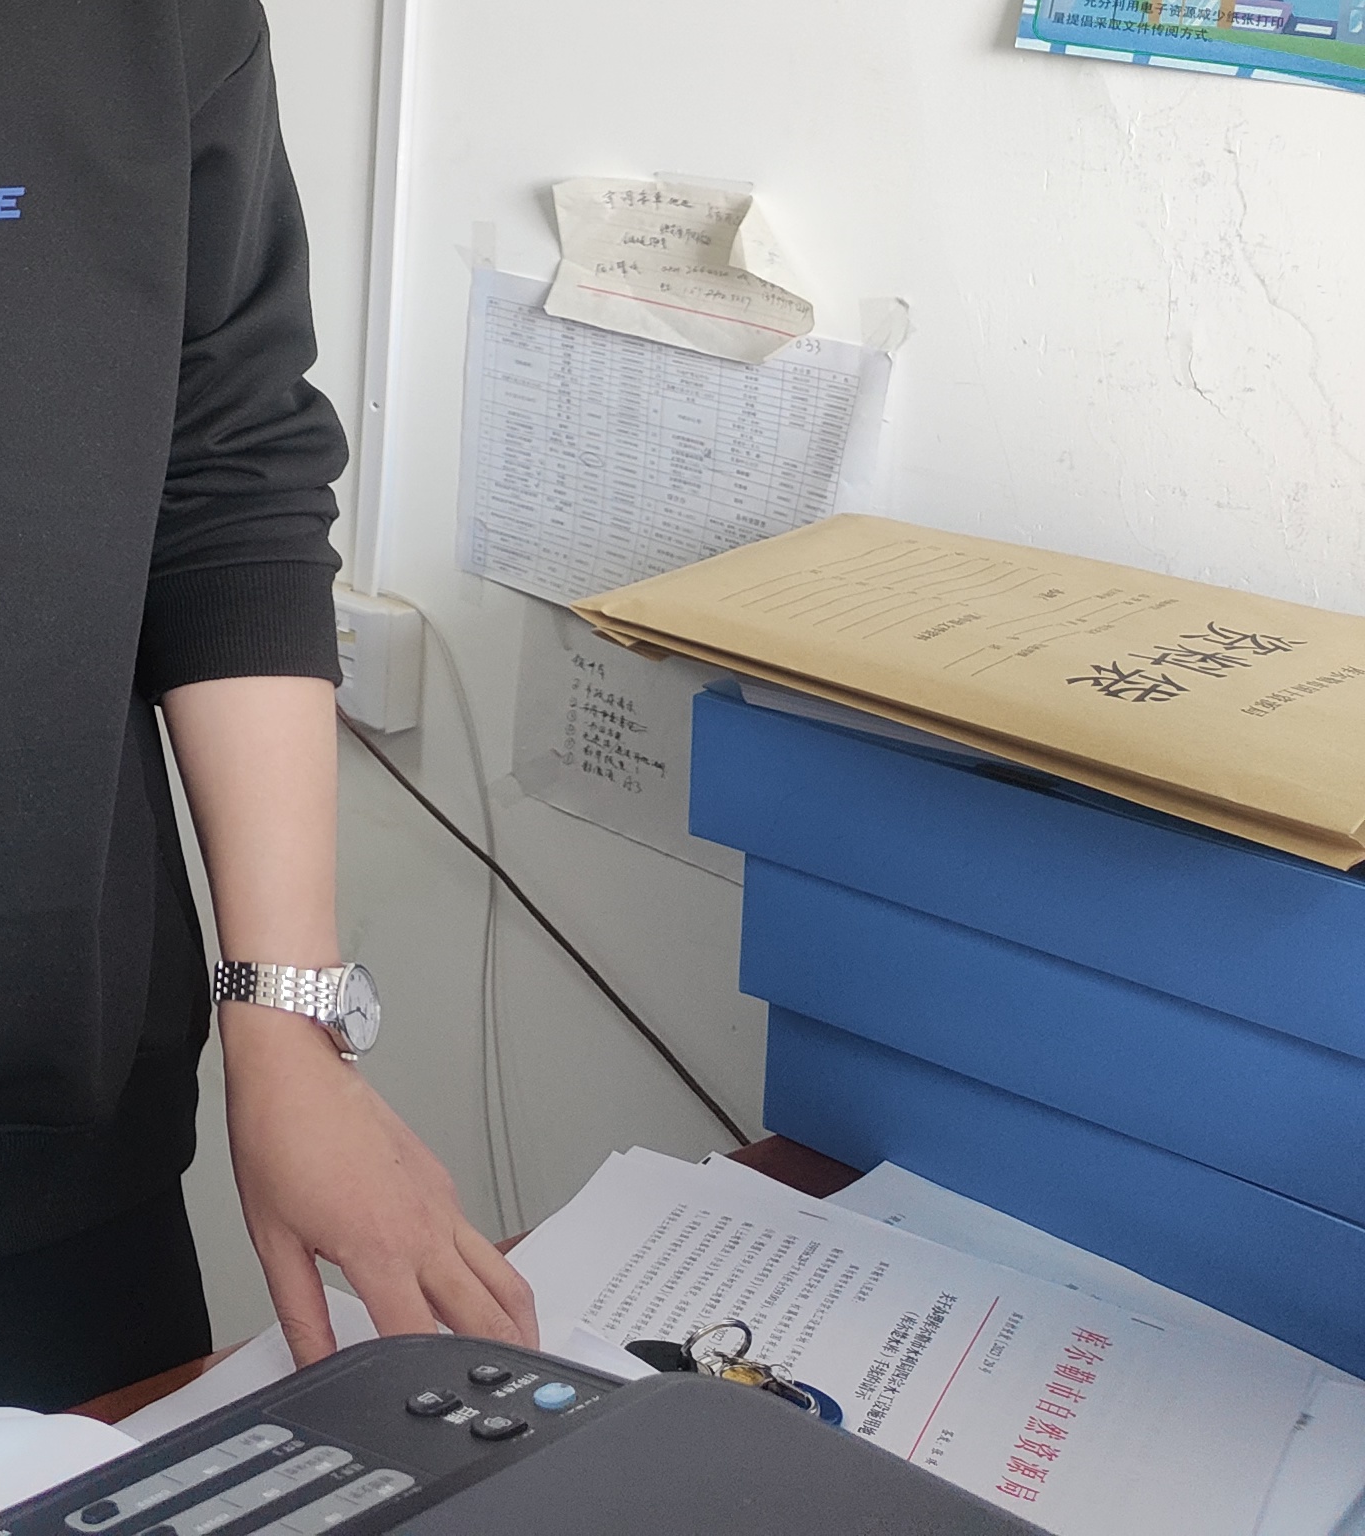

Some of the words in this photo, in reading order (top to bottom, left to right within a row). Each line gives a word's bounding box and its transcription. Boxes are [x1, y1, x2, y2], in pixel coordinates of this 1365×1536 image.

[1067, 620, 1307, 704] 资料袋
[995, 1326, 1113, 1504] 库尔勒市自然资源局
